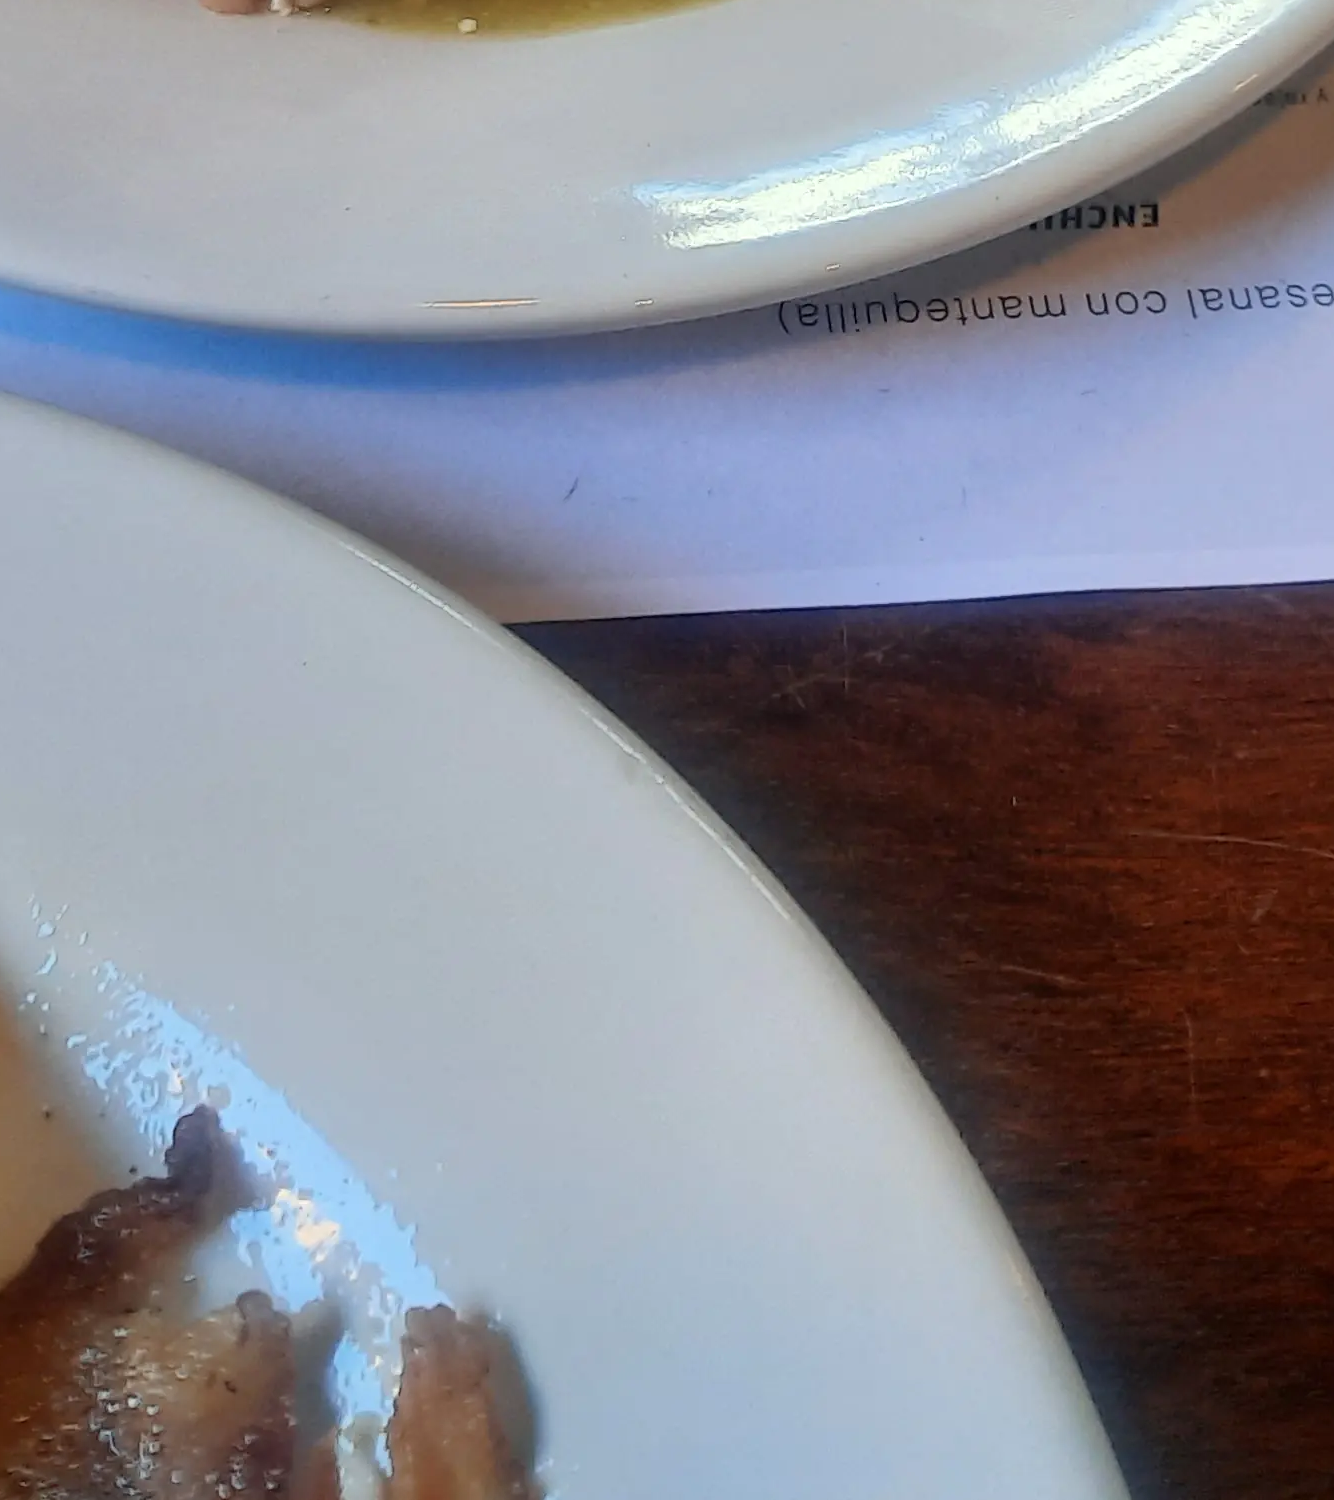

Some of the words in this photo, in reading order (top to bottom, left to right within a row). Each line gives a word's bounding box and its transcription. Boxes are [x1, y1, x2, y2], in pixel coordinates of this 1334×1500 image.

[1316, 86, 1329, 105] y
[777, 290, 1067, 335] mantequilla)
[1086, 290, 1166, 316] con
